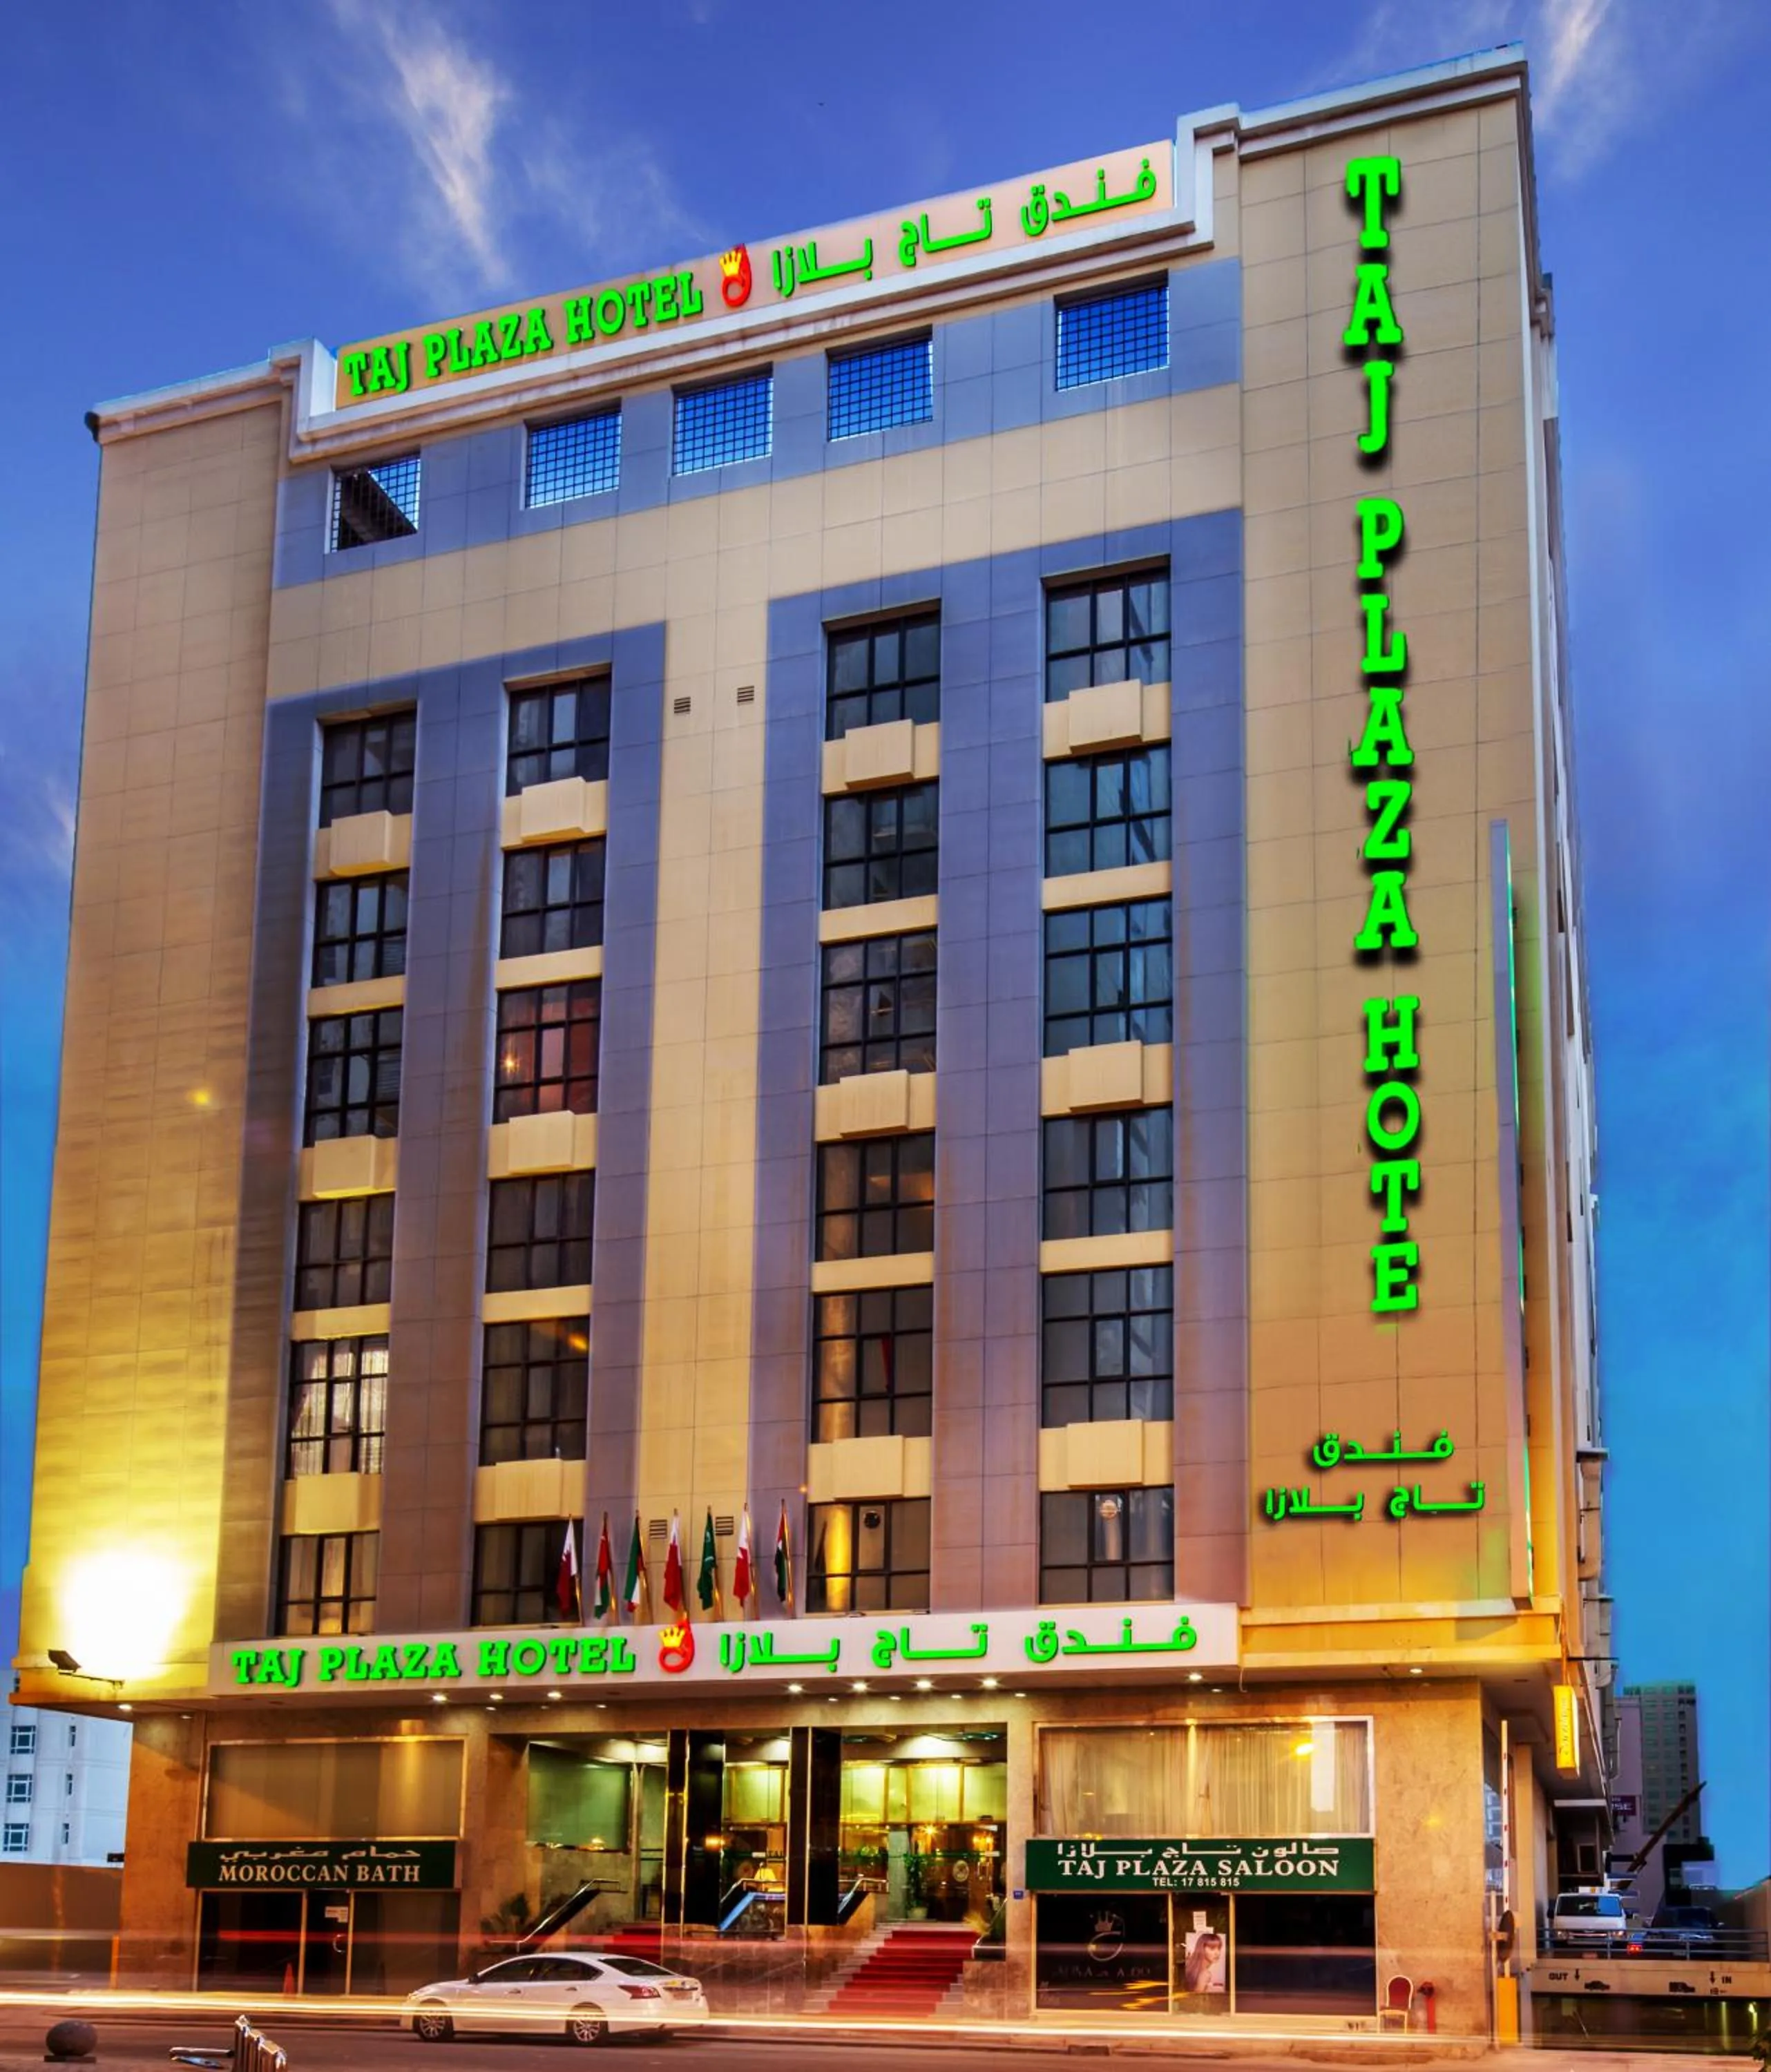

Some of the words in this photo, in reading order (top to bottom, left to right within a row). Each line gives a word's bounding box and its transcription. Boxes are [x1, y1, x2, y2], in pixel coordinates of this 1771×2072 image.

[1021, 159, 1157, 236] فندق
[899, 198, 993, 267] تاج
[772, 237, 872, 297] بلازا
[1342, 155, 1402, 453] TAJ
[343, 341, 411, 396] TAJ
[423, 308, 553, 378] PLAZA
[564, 271, 703, 344] HOTEL
[1352, 497, 1418, 950] PLAZA
[1362, 995, 1420, 1312] HOTE
[1313, 1428, 1455, 1468] فندق
[1265, 1485, 1364, 1520] بلازا
[1390, 1481, 1485, 1518] تاج
[719, 1631, 840, 1673] بلازا
[871, 1623, 988, 1669] تاج
[1024, 1615, 1198, 1663] فندق
[231, 1649, 305, 1687] TAJ
[318, 1642, 461, 1681] PLAZA
[477, 1636, 635, 1676] HOTEL
[1057, 1860, 1106, 1879] TAJ
[1116, 1860, 1208, 1876] PLAZA
[1218, 1859, 1339, 1877] SALOON
[1162, 1842, 1242, 1859] تاج
[1252, 1842, 1339, 1858] صالون
[218, 1865, 348, 1882] MOROCCAN
[356, 1865, 421, 1882] BATH
[1152, 1877, 1178, 1887] TEL:
[1182, 1877, 1194, 1886] 17
[1197, 1877, 1217, 1887] 815
[1220, 1877, 1241, 1887] 815
[1548, 1972, 1569, 1981] OUT
[1721, 1975, 1732, 1984] IN
